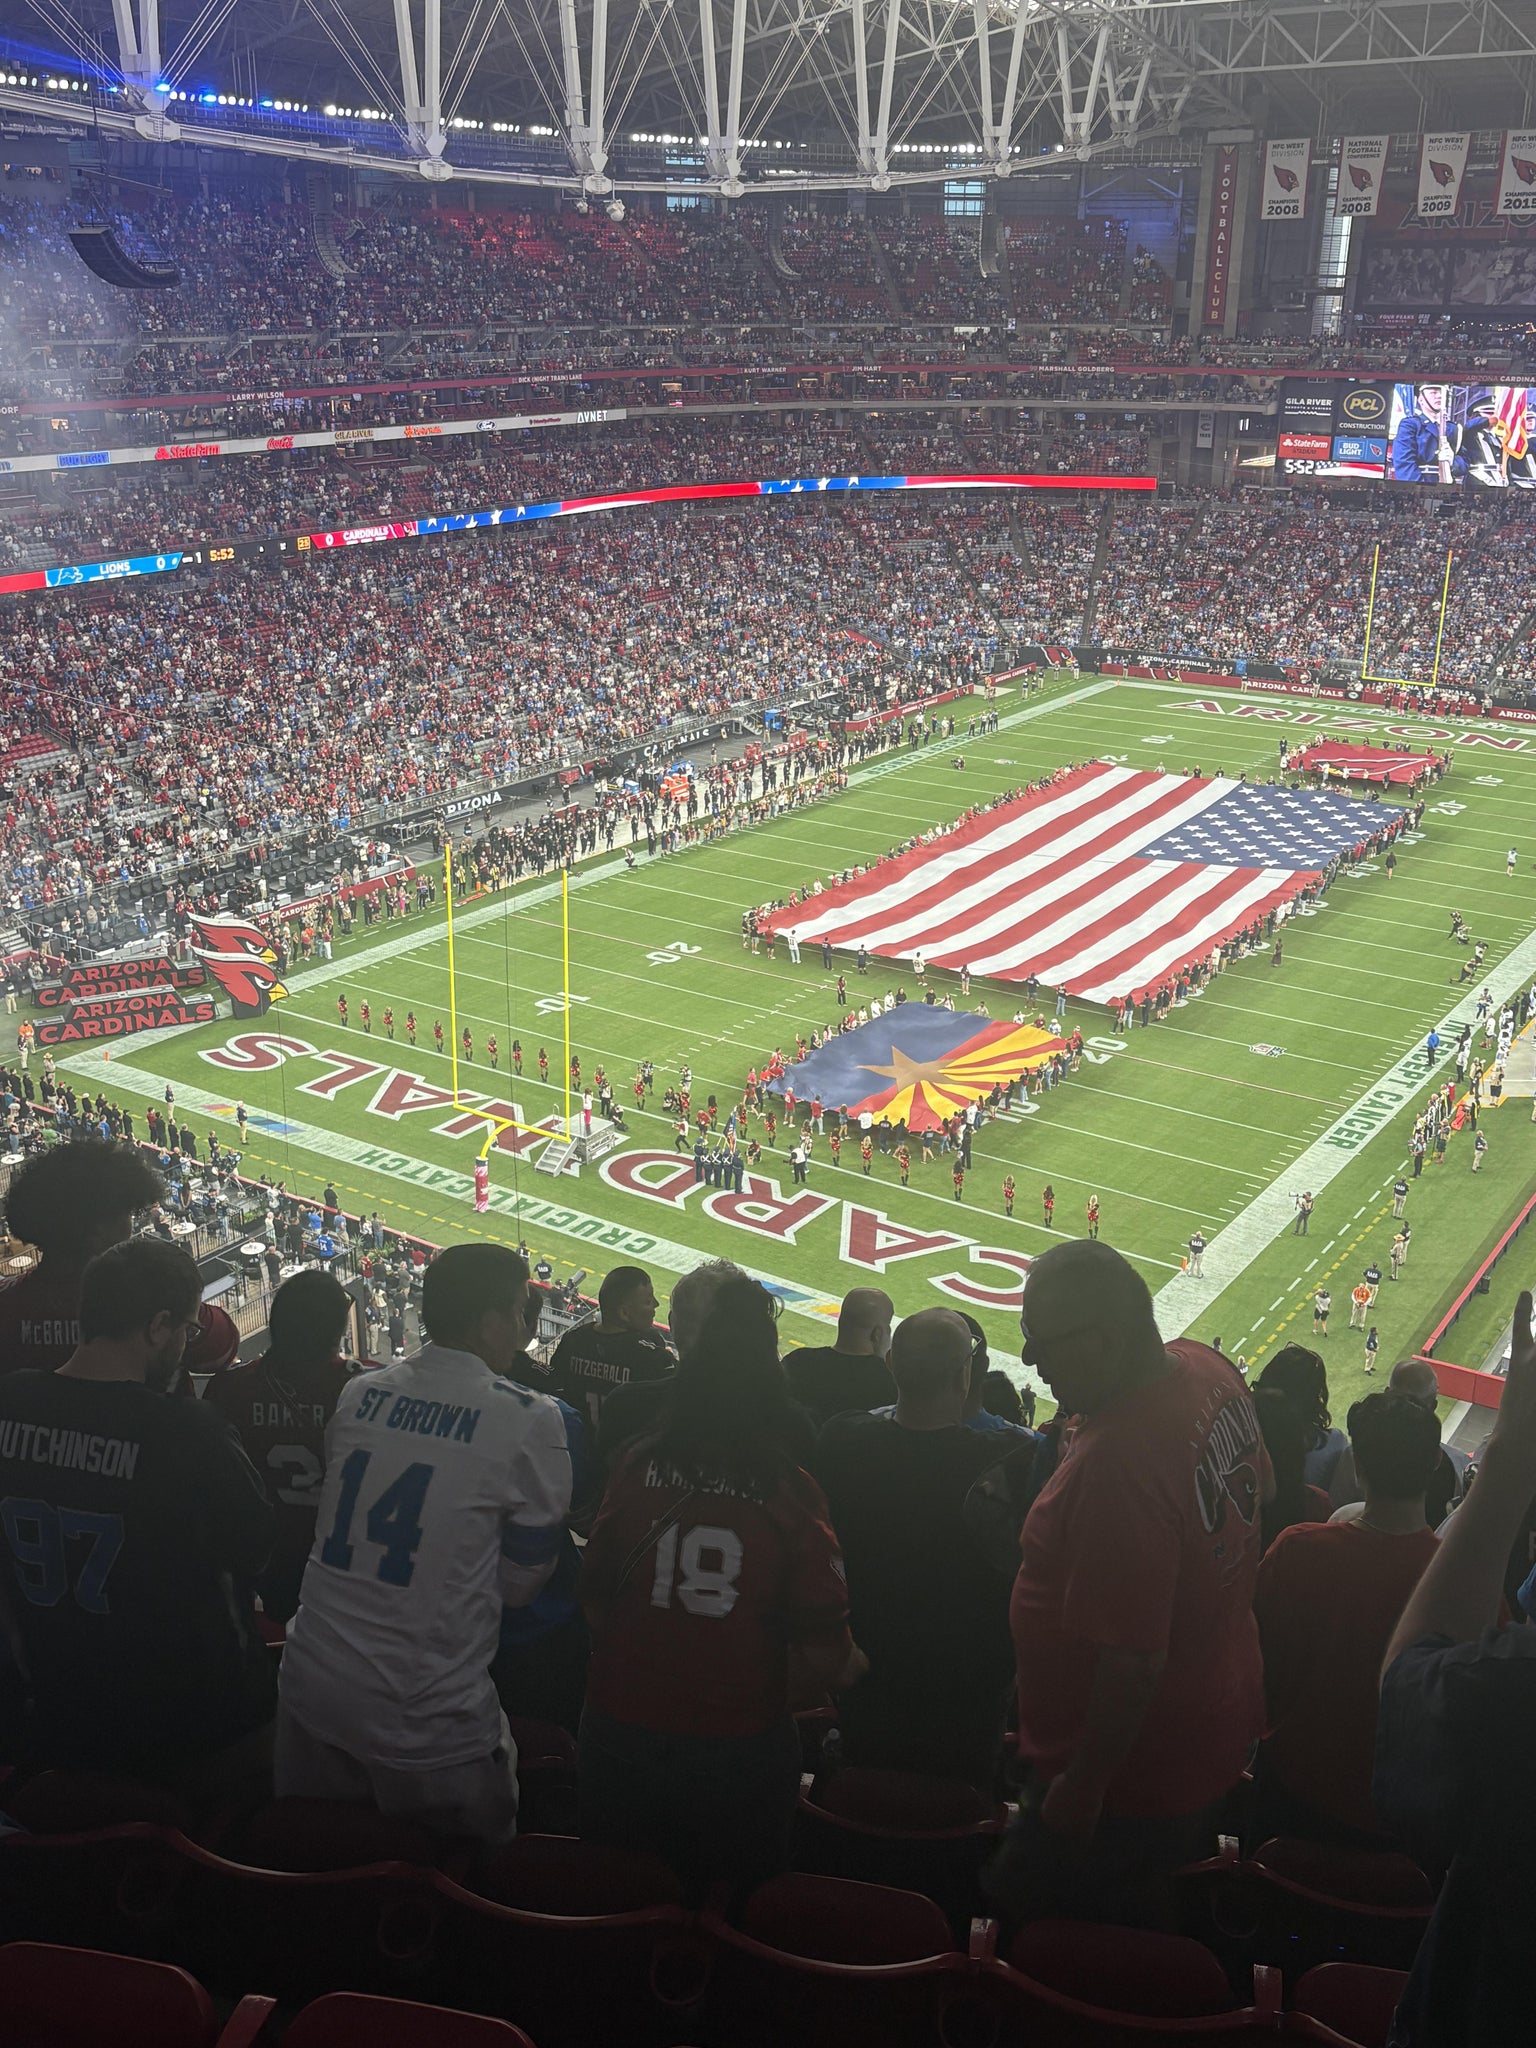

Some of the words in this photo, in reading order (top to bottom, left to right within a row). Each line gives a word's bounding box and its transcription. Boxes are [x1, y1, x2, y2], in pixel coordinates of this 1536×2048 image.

[1267, 205, 1299, 215] 2008
[1340, 202, 1371, 213] 2008
[1421, 201, 1451, 212] 2009
[1503, 198, 1536, 210] 2015
[518, 375, 530, 383] DICK
[232, 392, 256, 402] LARRY
[257, 391, 285, 400] WILSON
[1285, 397, 1305, 406] GILA
[1306, 398, 1332, 406] RIVER
[1349, 397, 1379, 411] PCL
[0, 406, 19, 415] ORF
[577, 410, 608, 423] AVNET
[1339, 422, 1386, 430] CONSTRUCTION
[1339, 448, 1362, 456] LIGHT
[326, 533, 333, 546] 0
[343, 527, 389, 542] CARDINALS
[209, 548, 235, 562] 5:52
[100, 561, 131, 575] LIONS
[156, 557, 165, 569] 0
[1137, 654, 1169, 664] ARIZONA
[1171, 658, 1210, 668] CARDINALS
[1246, 680, 1288, 692] ARIZONA
[1290, 685, 1344, 697] CARDNALS
[1157, 698, 1536, 754] ARIZON
[645, 941, 703, 964] 20
[70, 958, 171, 984] ARIZONA
[73, 993, 179, 1020] ARIZONA
[39, 1004, 214, 1044] CARDINALS
[1323, 1090, 1404, 1150] CANCER
[197, 1032, 1030, 1312] CARDNALS
[352, 1148, 477, 1195] CATCH
[489, 1189, 658, 1254] CRUCIAL
[570, 1355, 631, 1384] FITZGERALD
[252, 1402, 325, 1428] BAKER
[354, 1387, 393, 1422] ST
[386, 1396, 481, 1444] BROWN
[320, 1447, 435, 1588] 14
[0, 1495, 126, 1614] 97
[650, 1521, 744, 1619] 18
